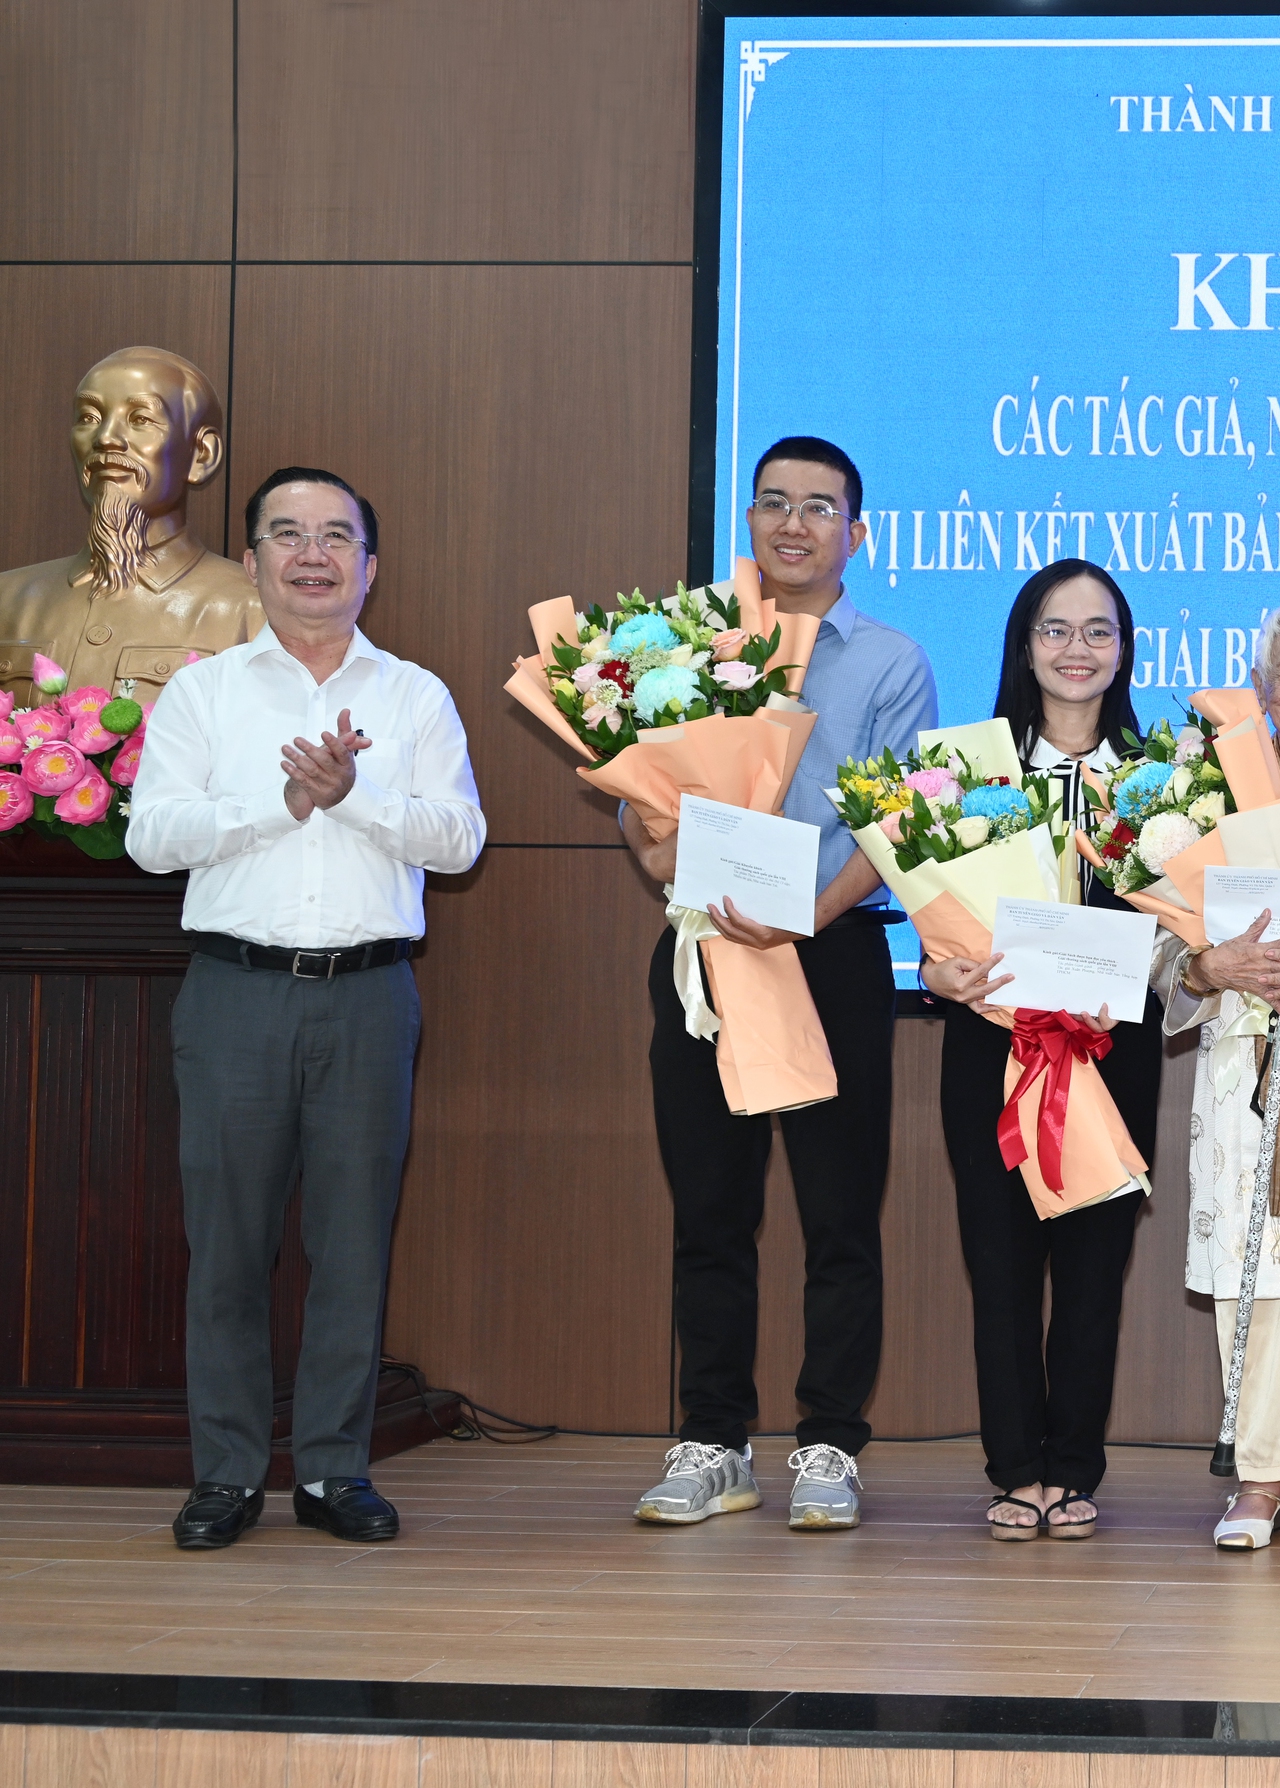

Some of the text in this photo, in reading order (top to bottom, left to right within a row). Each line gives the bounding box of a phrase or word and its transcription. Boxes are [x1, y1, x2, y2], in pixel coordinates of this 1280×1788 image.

[1111, 83, 1272, 133] THÀNH
[993, 377, 1075, 457] CÁC
[1086, 377, 1165, 458] TÁC
[1176, 378, 1257, 470] GIẢ,
[860, 510, 901, 589] VỊ
[911, 489, 1004, 572] LIÊN
[1014, 491, 1095, 571] KẾT
[1104, 491, 1213, 573] XUẤT
[1130, 607, 1212, 689] GIẢI
